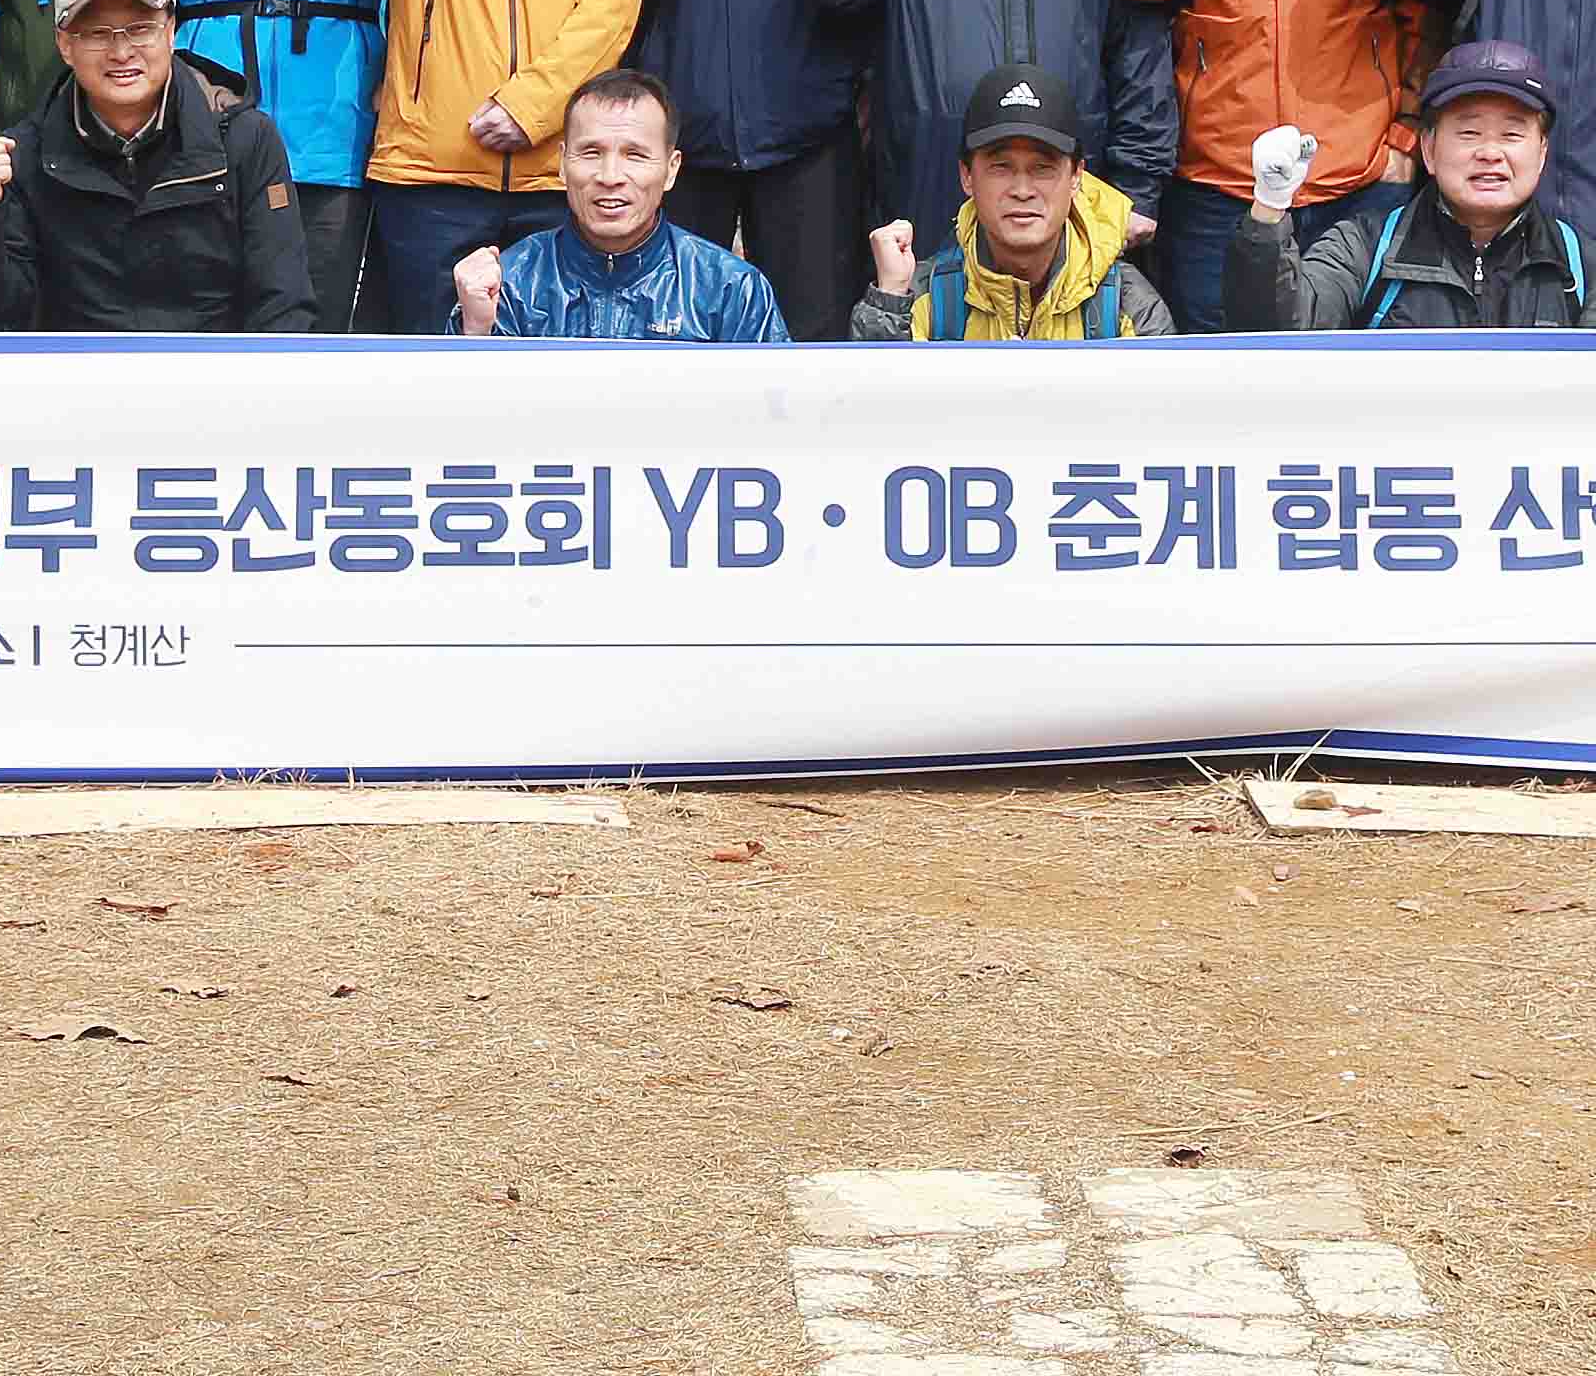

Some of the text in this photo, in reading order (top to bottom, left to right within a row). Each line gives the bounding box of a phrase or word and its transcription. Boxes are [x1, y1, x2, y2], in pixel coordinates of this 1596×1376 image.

[999, 96, 1043, 109] adidas
[130, 465, 611, 572] 등산동호회
[643, 467, 784, 568] YB
[884, 465, 1017, 569] OB
[1048, 463, 1237, 571] 춘계
[1267, 464, 1462, 571] 합동
[70, 624, 191, 667] 청계산
